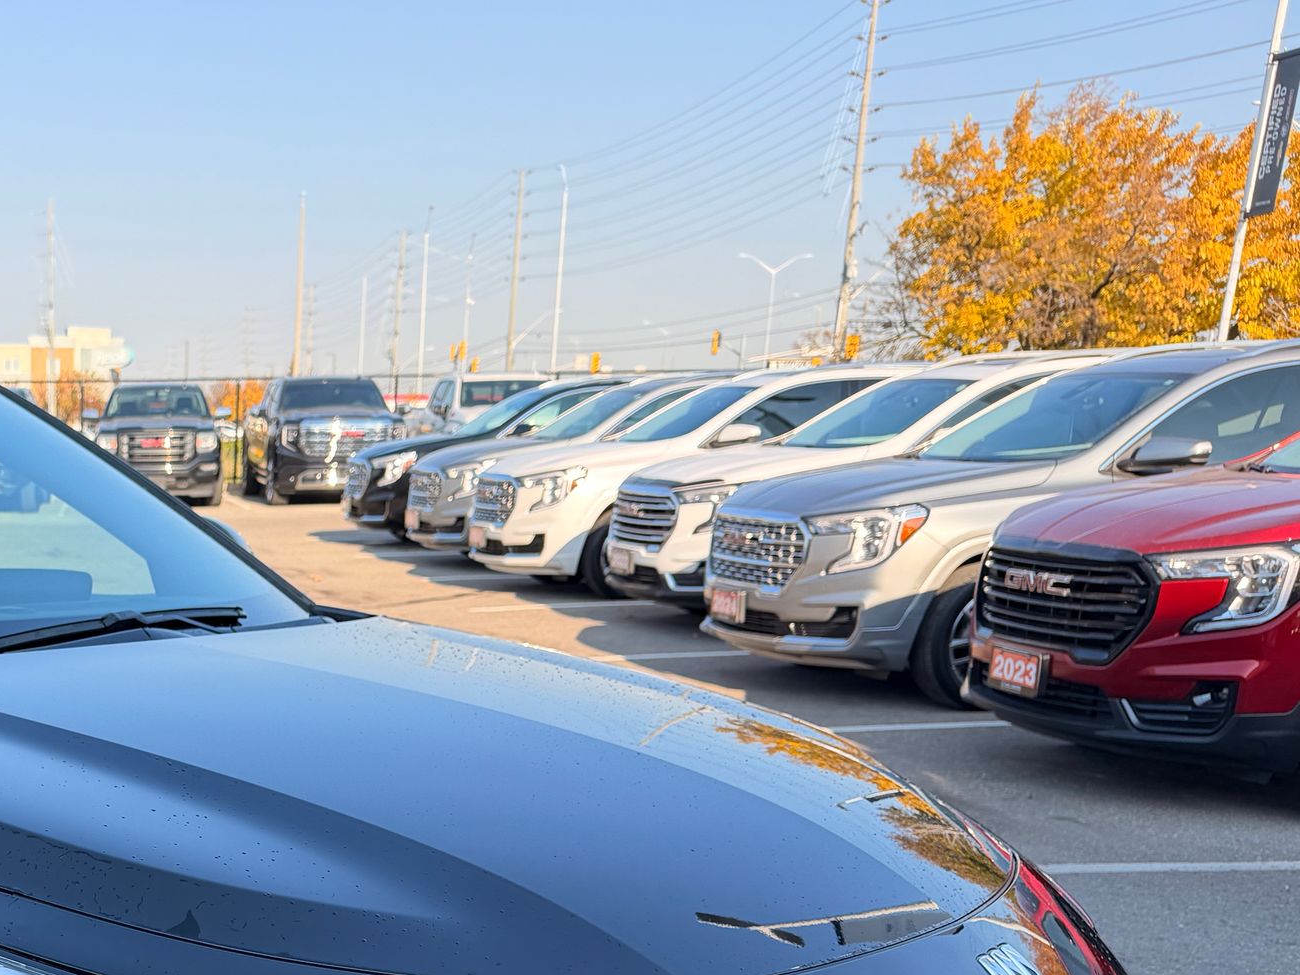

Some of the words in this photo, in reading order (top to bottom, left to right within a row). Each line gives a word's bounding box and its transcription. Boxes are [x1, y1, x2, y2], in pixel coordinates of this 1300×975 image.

[1258, 84, 1282, 180] CERTIFIED
[1266, 86, 1287, 174] PRE-OWNED
[1004, 567, 1074, 597] GMC
[994, 654, 1037, 687] 2023
